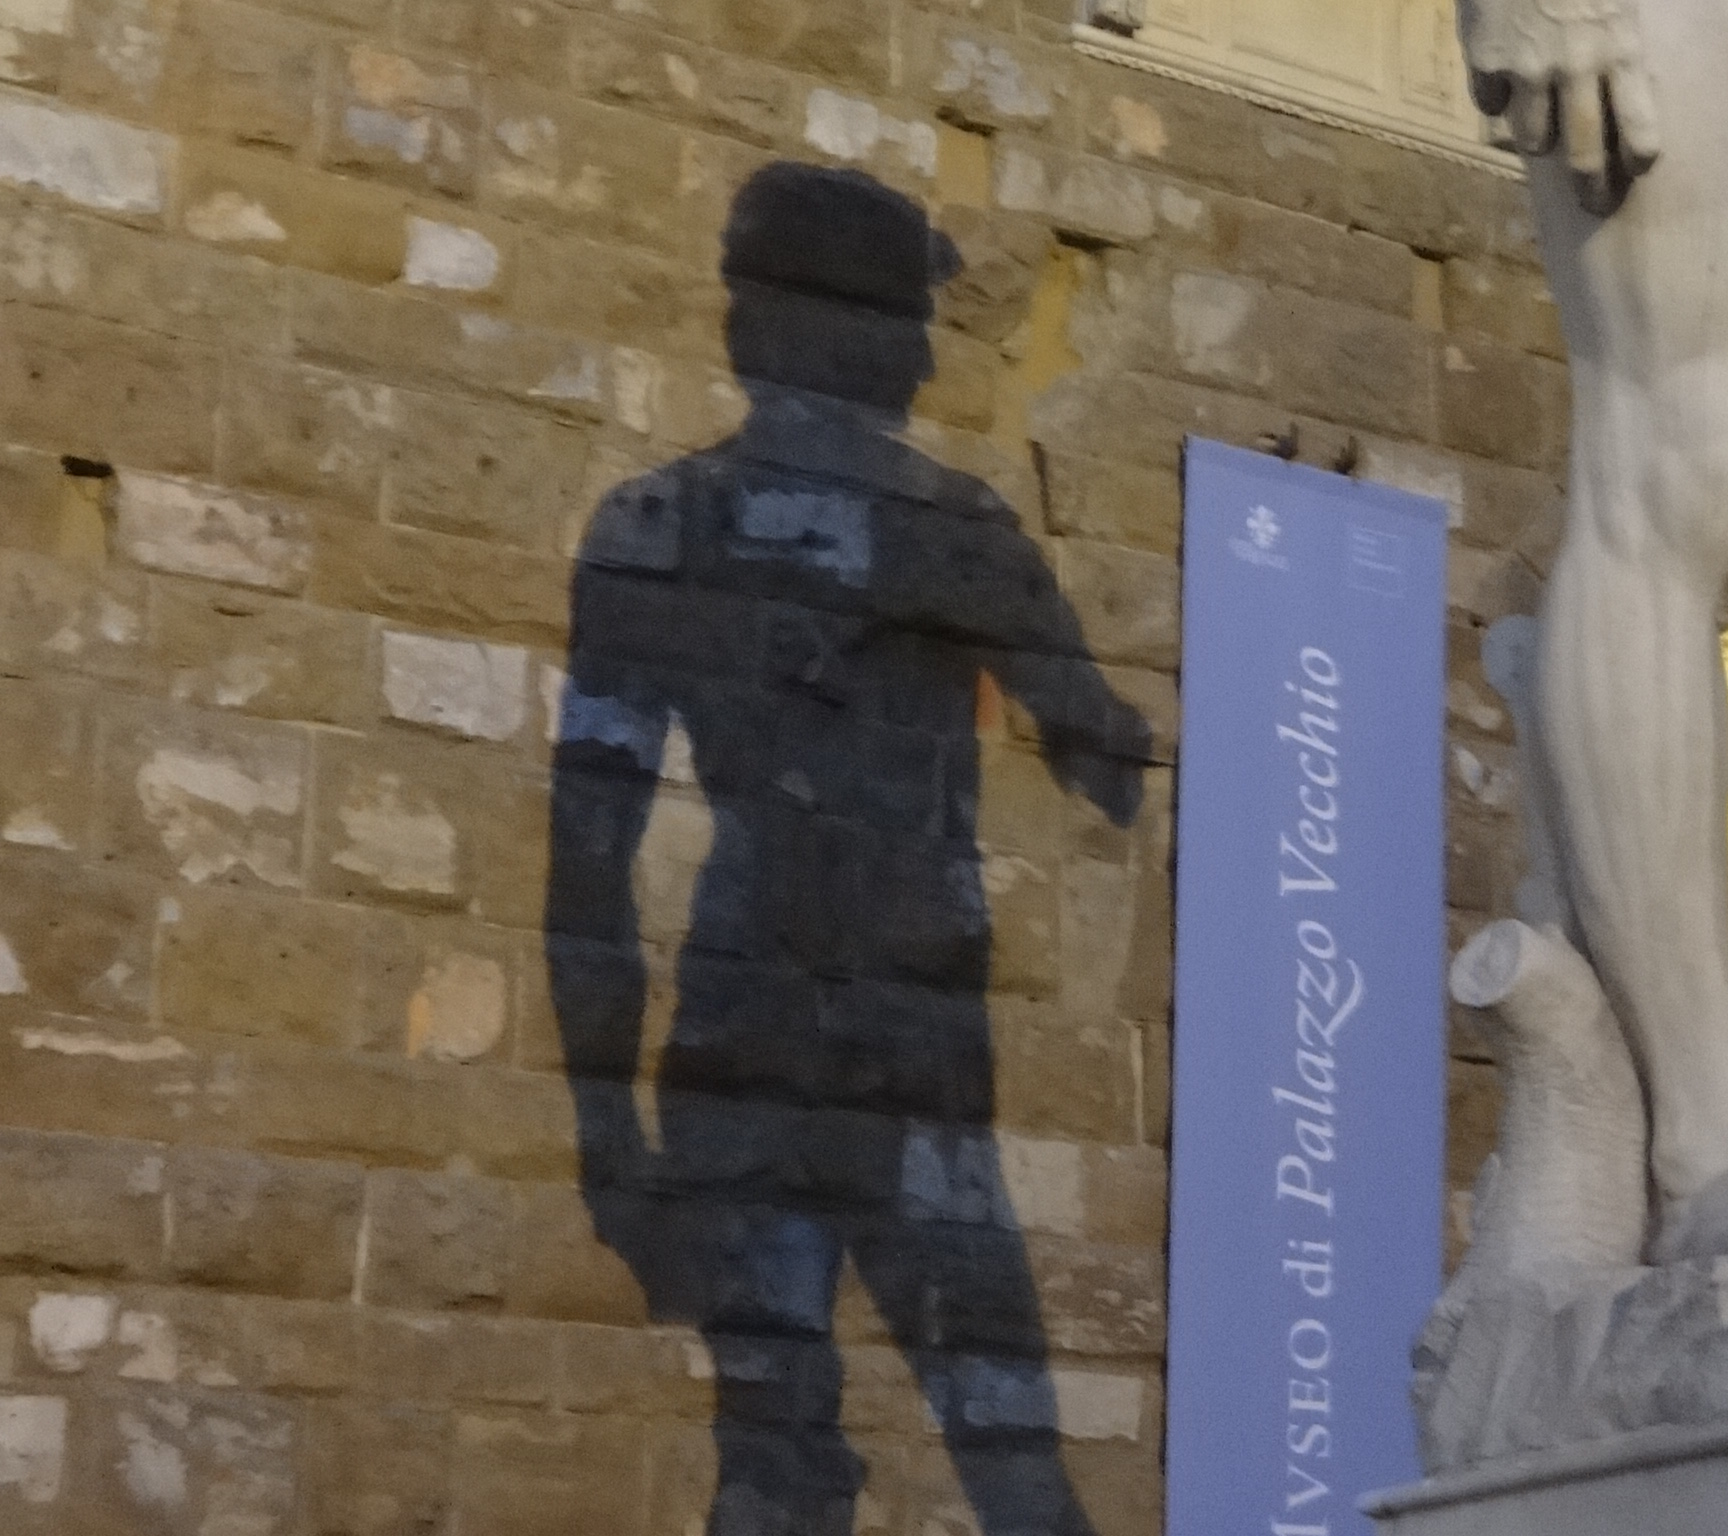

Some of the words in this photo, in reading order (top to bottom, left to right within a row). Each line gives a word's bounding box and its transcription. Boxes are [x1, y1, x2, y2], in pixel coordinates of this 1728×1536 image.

[1277, 646, 1342, 896] Vecchio
[1273, 919, 1363, 1217] Palazzo
[1282, 1239, 1334, 1297] di
